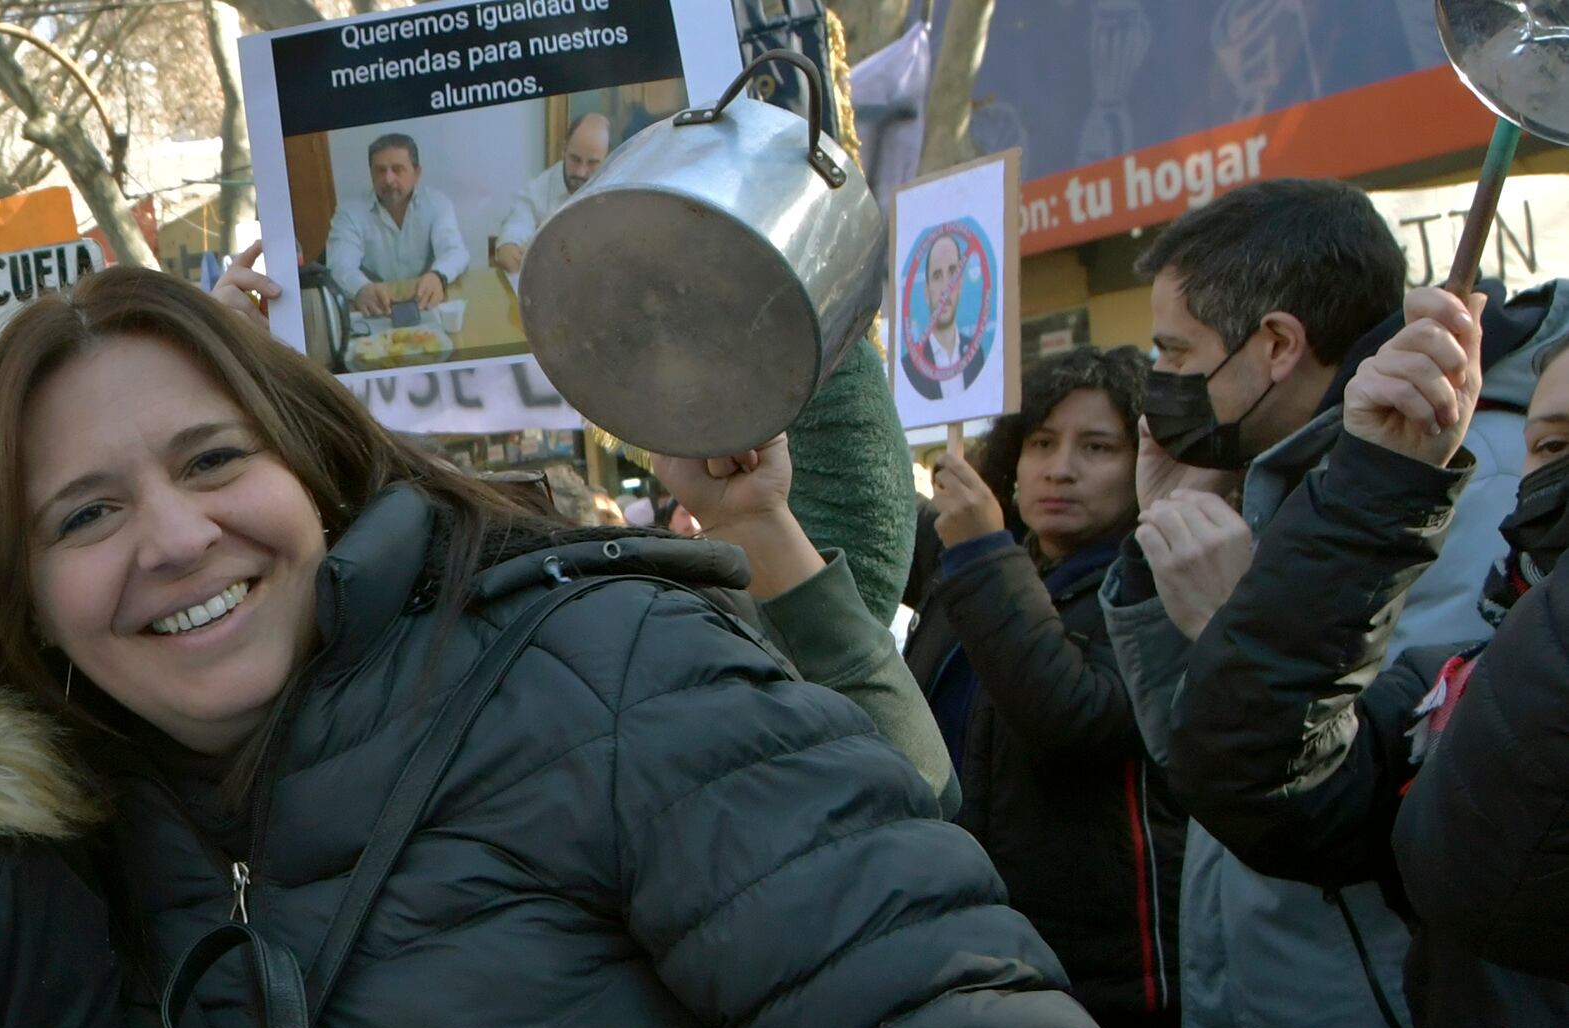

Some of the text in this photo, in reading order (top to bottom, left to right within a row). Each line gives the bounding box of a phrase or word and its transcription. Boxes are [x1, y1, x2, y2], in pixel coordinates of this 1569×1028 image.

[341, 9, 469, 49] Queremos
[477, 0, 576, 33] igualdad
[331, 25, 628, 88] meriendas para nuestros
[430, 75, 544, 110] alumnos.
[1065, 177, 1112, 223] tu
[1123, 134, 1268, 208] hogar
